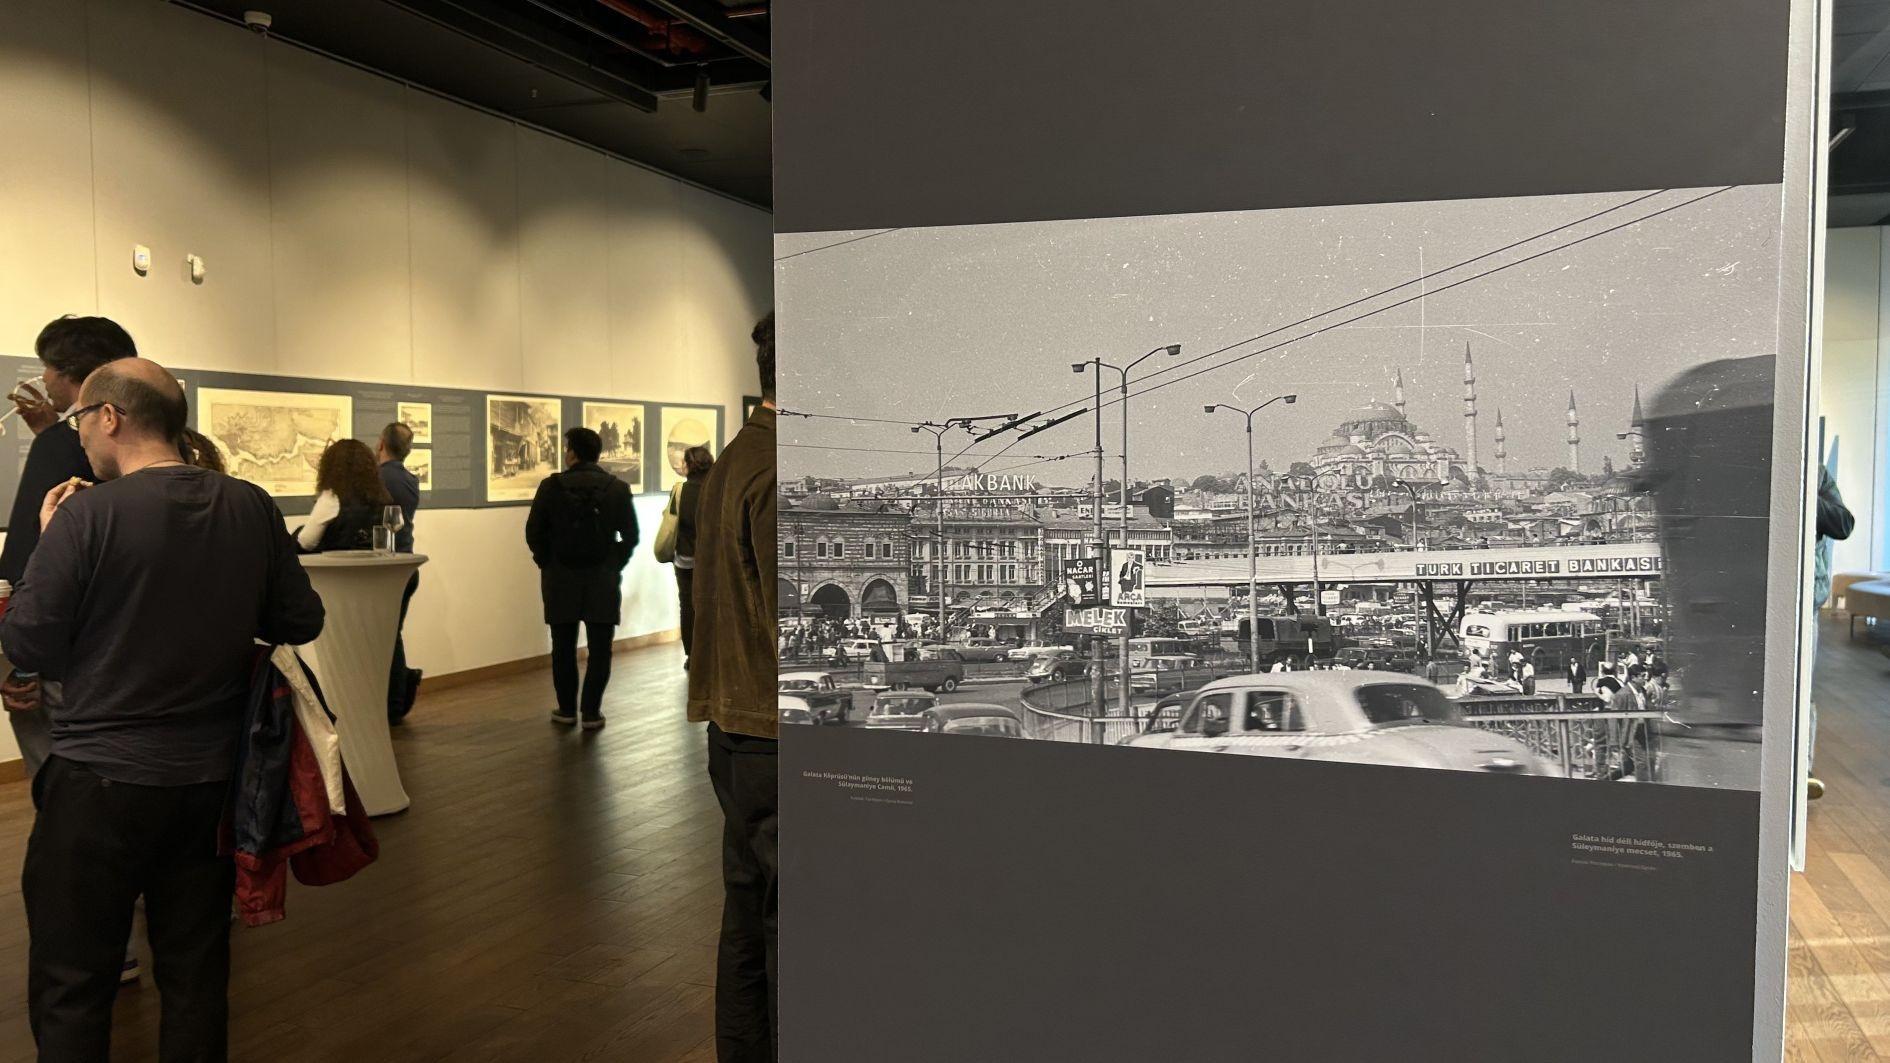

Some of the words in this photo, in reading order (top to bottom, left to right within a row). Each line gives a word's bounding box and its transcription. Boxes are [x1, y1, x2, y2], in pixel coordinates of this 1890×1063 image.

[962, 473, 1036, 490] AKBANK
[1234, 474, 1373, 490] ANADOLU
[1066, 566, 1094, 575] NACAR
[1416, 563, 1462, 575] TURK
[1470, 560, 1559, 575] TICARET
[1117, 592, 1143, 601] ARCA
[1065, 607, 1127, 628] MELEK
[803, 770, 823, 778] Galata
[1572, 833, 1599, 843] Galata
[1571, 842, 1625, 854] Süleymaniye
